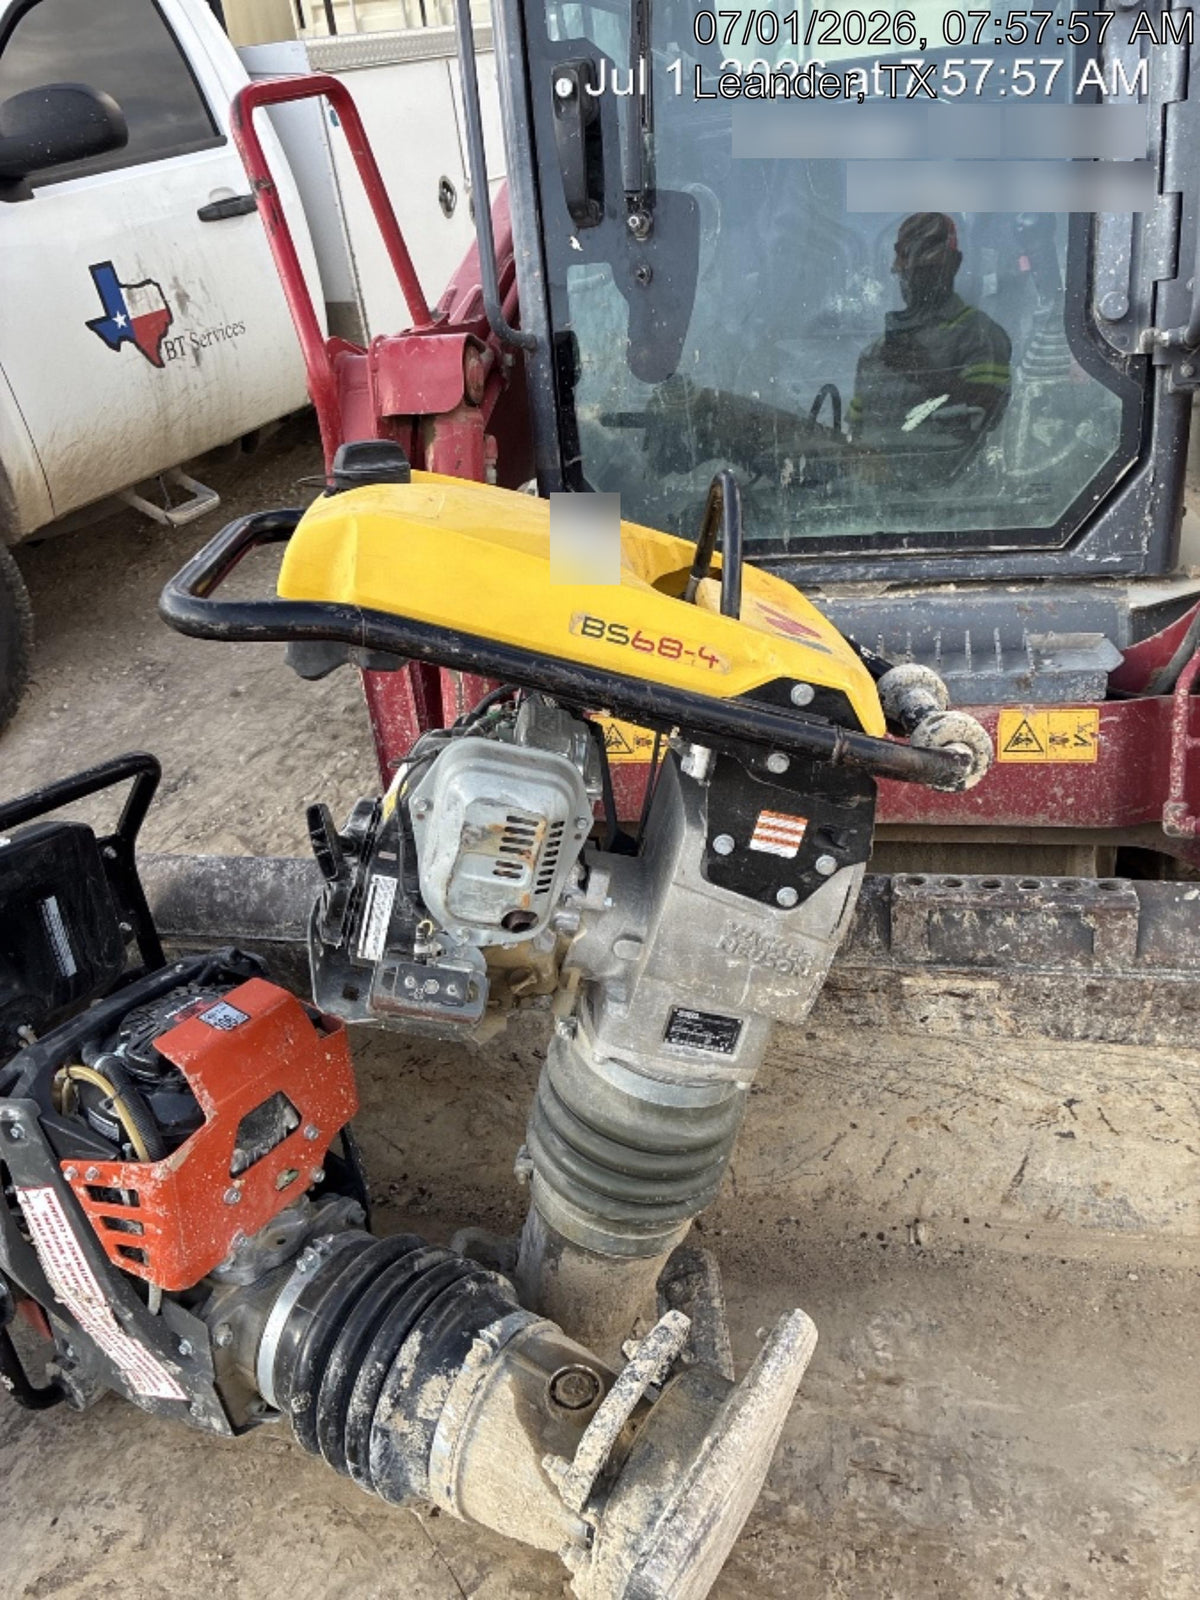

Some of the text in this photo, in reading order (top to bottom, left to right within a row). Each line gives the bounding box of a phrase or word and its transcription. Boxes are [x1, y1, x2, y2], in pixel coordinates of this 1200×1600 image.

[164, 320, 246, 361] BT Services
[581, 616, 719, 668] BS68-4
